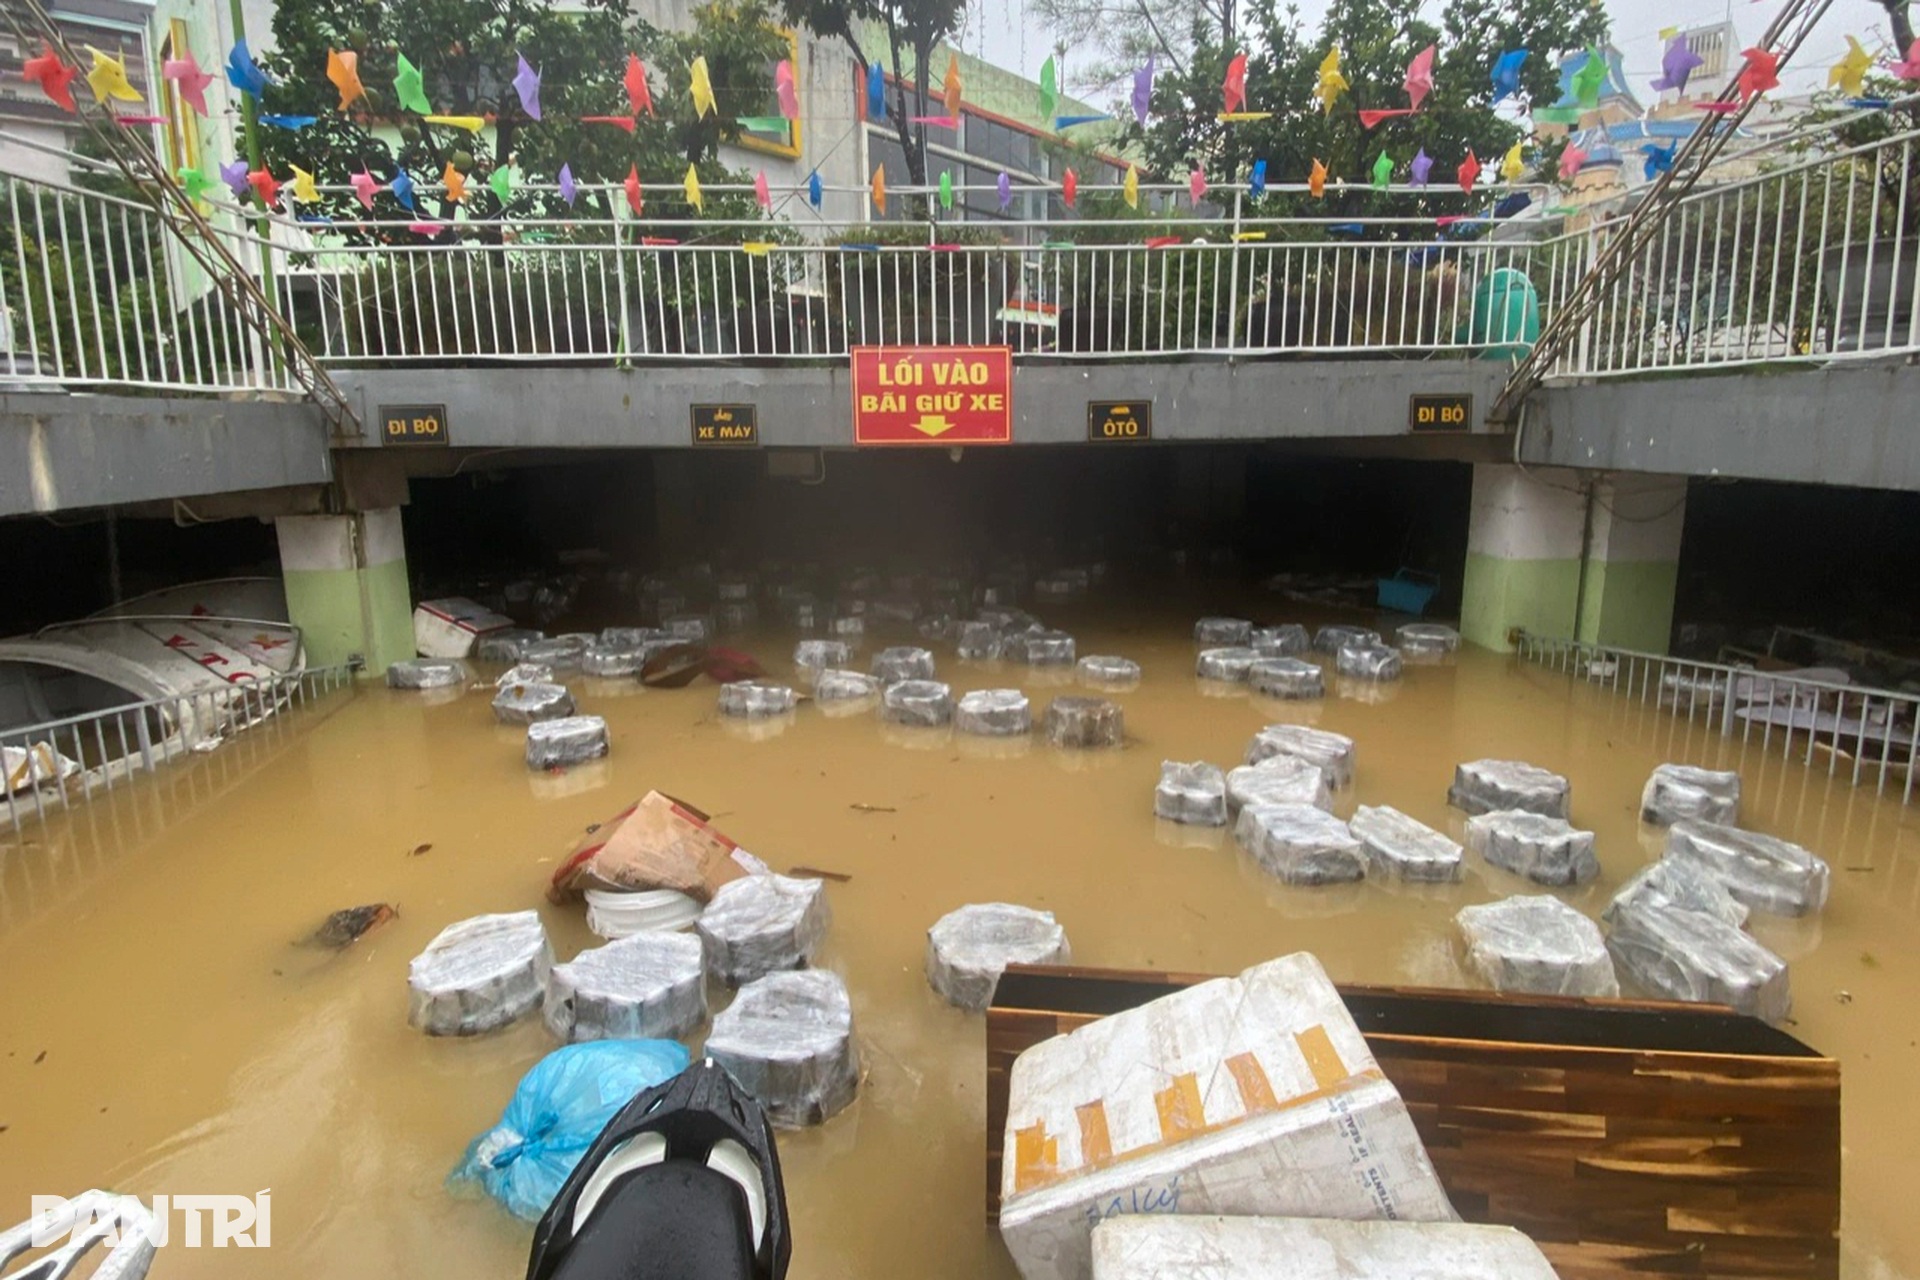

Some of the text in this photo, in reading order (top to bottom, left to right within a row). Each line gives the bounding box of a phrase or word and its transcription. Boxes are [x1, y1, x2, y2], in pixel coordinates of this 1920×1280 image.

[878, 355, 989, 386] LỐI VÀO
[861, 391, 1004, 413] BÃI GIỮ XE
[1418, 403, 1464, 425] ĐI BỘ
[388, 415, 438, 436] ĐI BỘ
[698, 423, 752, 438] XE MÁY
[1103, 417, 1138, 436] ÔTÔ
